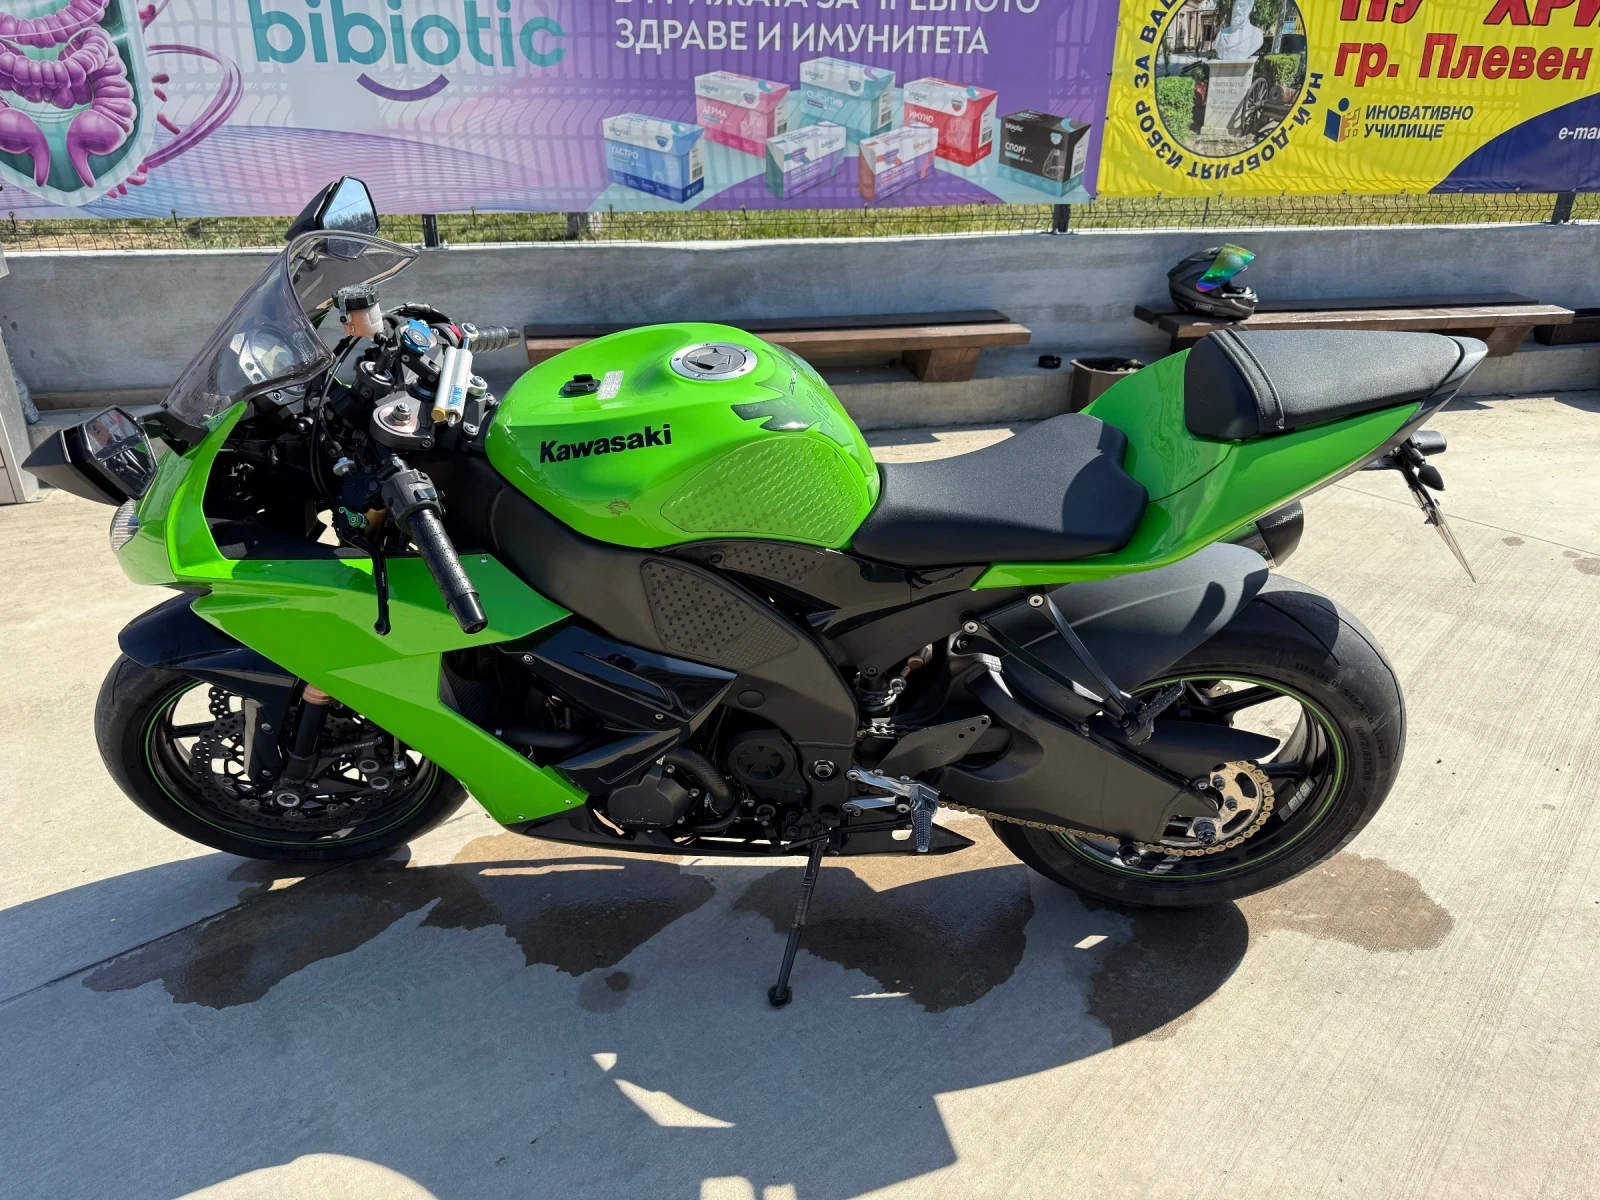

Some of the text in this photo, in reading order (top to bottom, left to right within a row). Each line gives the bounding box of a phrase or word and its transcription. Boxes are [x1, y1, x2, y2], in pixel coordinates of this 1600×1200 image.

[249, 0, 567, 67] bibiotic
[615, 17, 989, 55] ЗДРАВЕ И ИМУНИТЕТА
[1134, 54, 1150, 88] ЗА
[1333, 33, 1594, 87] гр. Плевен
[909, 109, 934, 123] ИМУНО
[1186, 72, 1324, 180] НАЙ-ДОБРИЯТ
[1365, 104, 1474, 121] ИНОВАТИВНО
[1004, 142, 1027, 155] СПОРТ
[1135, 100, 1184, 170] ИЗБОР
[1364, 123, 1445, 141] УЧИЛИЩЕ
[611, 145, 639, 160] ГАСТРО
[539, 423, 673, 464] Kawasaki
